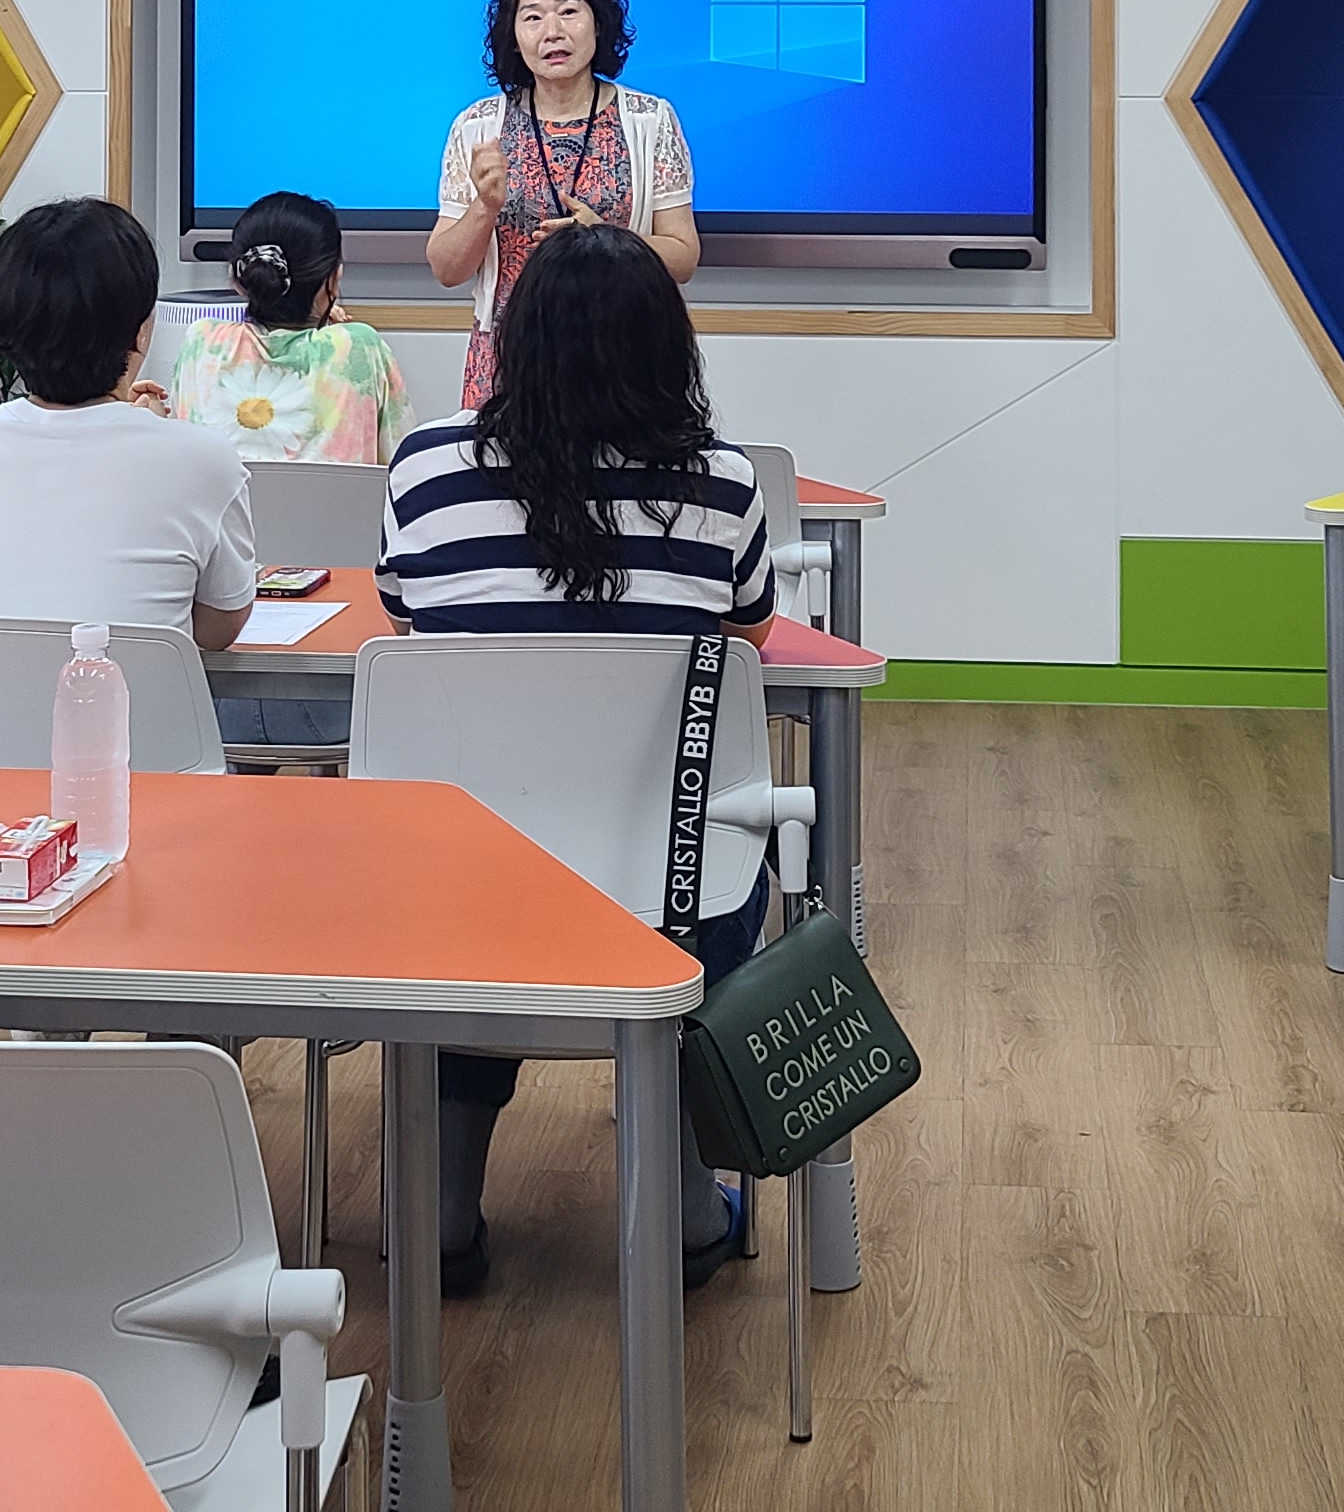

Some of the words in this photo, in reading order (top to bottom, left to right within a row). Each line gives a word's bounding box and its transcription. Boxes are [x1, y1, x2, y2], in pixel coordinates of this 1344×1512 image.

[695, 634, 723, 673] BRI
[683, 685, 715, 759] BBYB
[671, 767, 703, 913] CRISTALLO
[746, 974, 854, 1064] BRILLA
[766, 1034, 838, 1101] COME
[832, 1009, 873, 1049] UN
[783, 1047, 891, 1140] CRISTALLO
